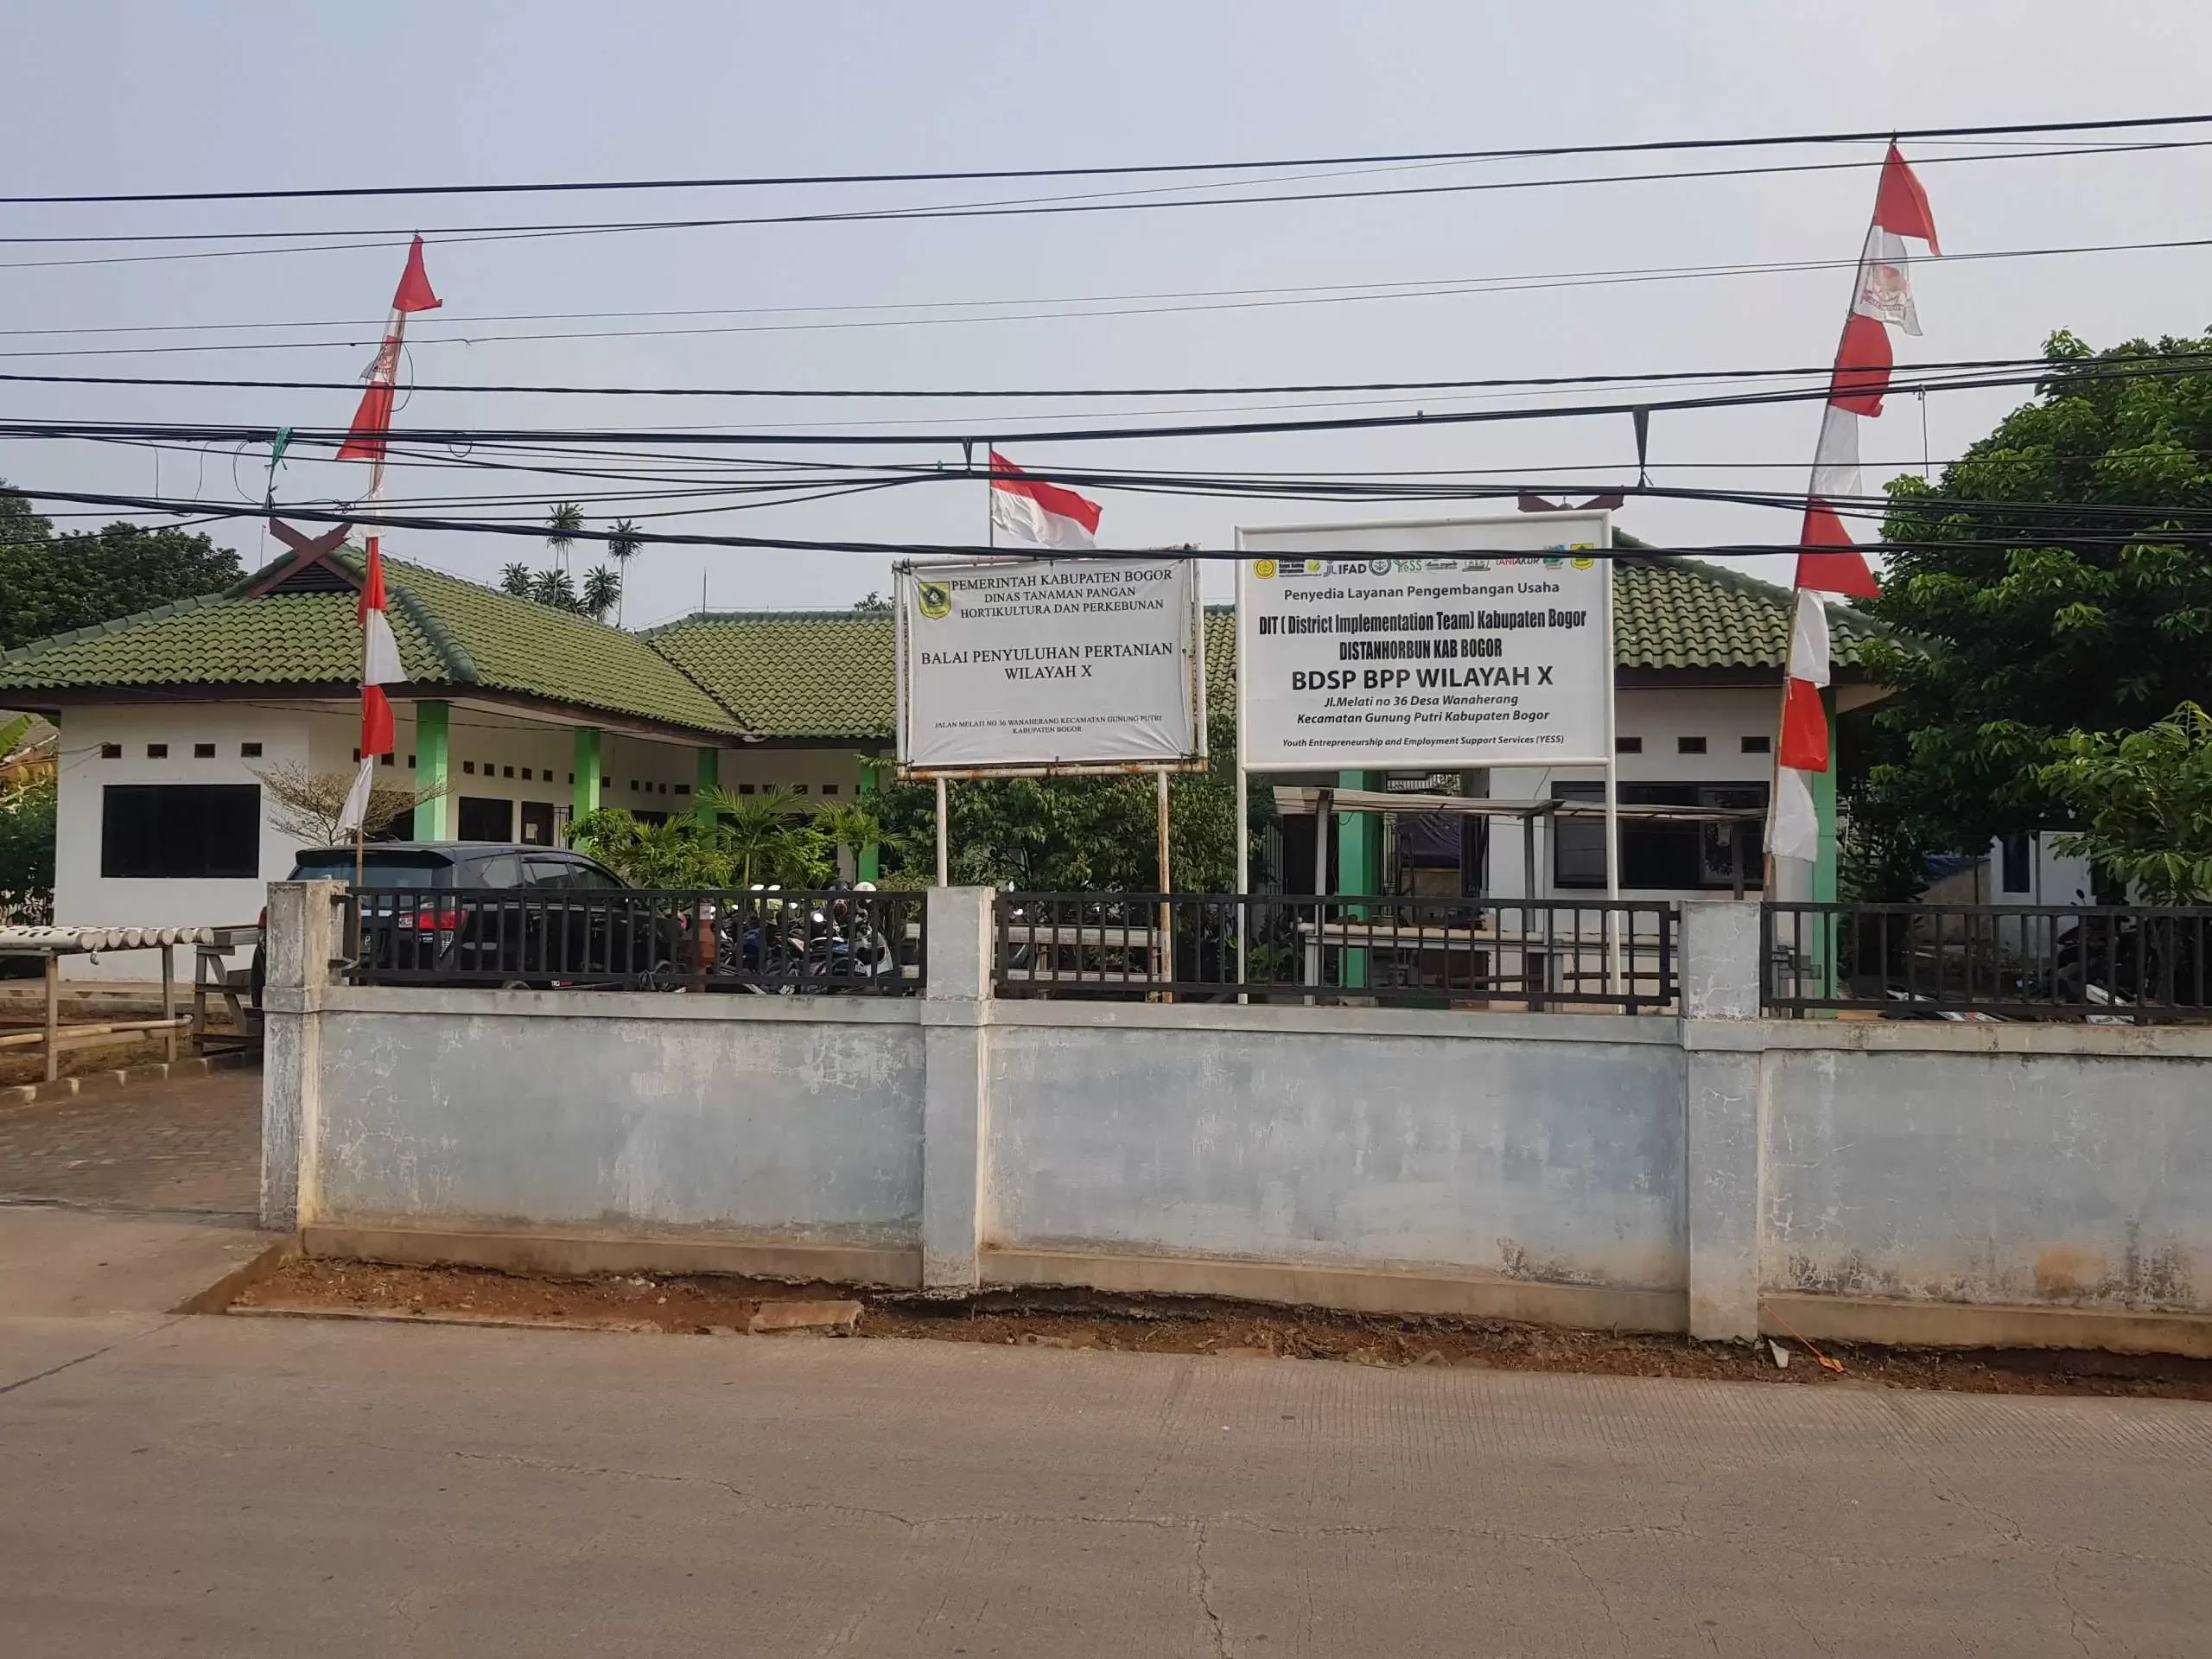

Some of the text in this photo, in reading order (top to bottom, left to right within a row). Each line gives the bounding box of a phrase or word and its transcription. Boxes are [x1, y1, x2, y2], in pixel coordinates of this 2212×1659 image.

[1339, 564, 1366, 574] IFAD
[951, 569, 1172, 592] PEMERINTAH KABUPATEN BOGOR
[985, 587, 1135, 602] DINAS TANAMAN PANGAN
[1285, 582, 1559, 602] Penyedia Layanan Pengembangan Usaha
[961, 600, 1163, 618] HORTIKULTURA DAN PERKEBUNAN
[1260, 616, 1278, 634] DIT
[1288, 615, 1332, 634] District
[1335, 613, 1434, 634] Implementation
[1436, 611, 1474, 630] Team)
[1478, 610, 1545, 630] Kabupaten
[1548, 608, 1586, 629] Bogor
[921, 643, 1172, 664] BALAI PENYULUHAN PERTANIAN
[1340, 639, 1502, 660] DISTANHORBUN KAB BOGOR
[1005, 665, 1092, 679] WILAYAH X
[1293, 666, 1553, 690] BDSP BPP WILAYAH X
[1324, 696, 1373, 707] Jl.Melati
[1394, 696, 1408, 705] 36
[1410, 696, 1439, 705] Desa
[1443, 695, 1518, 706] Wanaherang
[1007, 717, 1059, 726] WANAHERANG
[1298, 710, 1549, 724] Kecamatan Gunung Putri Kabupaten Bogor
[1309, 738, 1382, 747] Entrepreneurship
[1403, 737, 1459, 747] Employment
[1460, 737, 1496, 746] Support
[1536, 735, 1564, 744] (YESS)
